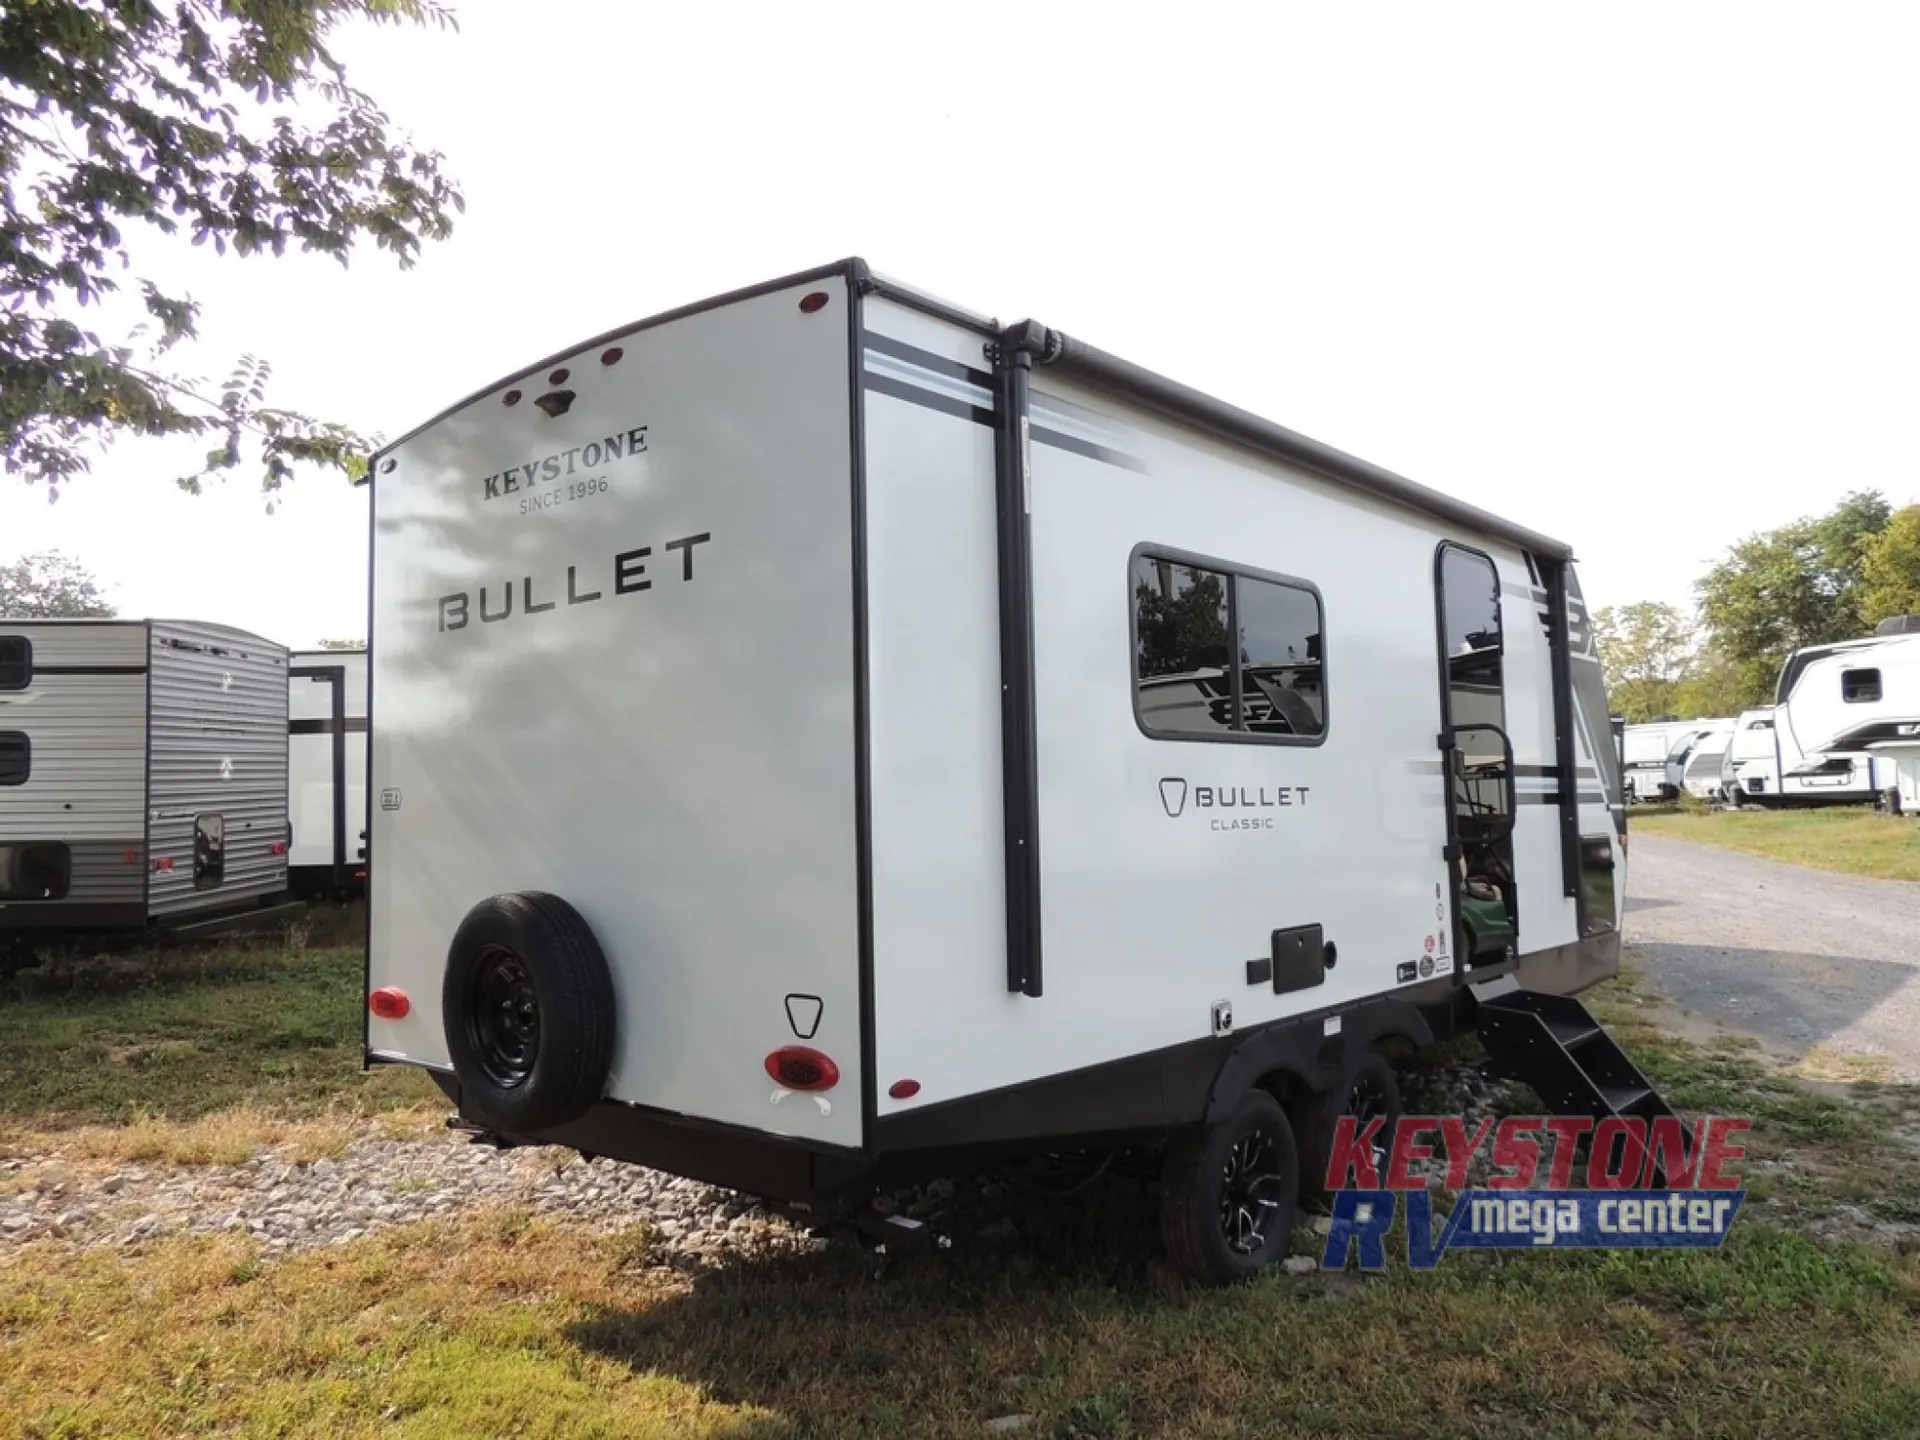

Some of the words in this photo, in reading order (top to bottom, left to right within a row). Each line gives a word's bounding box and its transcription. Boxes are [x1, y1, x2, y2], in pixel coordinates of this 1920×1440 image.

[484, 426, 648, 500] KEYSTONE
[519, 488, 562, 515] SINCE
[568, 475, 609, 502] 1996
[438, 532, 711, 633] BULLET
[1195, 787, 1310, 807] BULLET
[1211, 818, 1274, 831] CLASSIC
